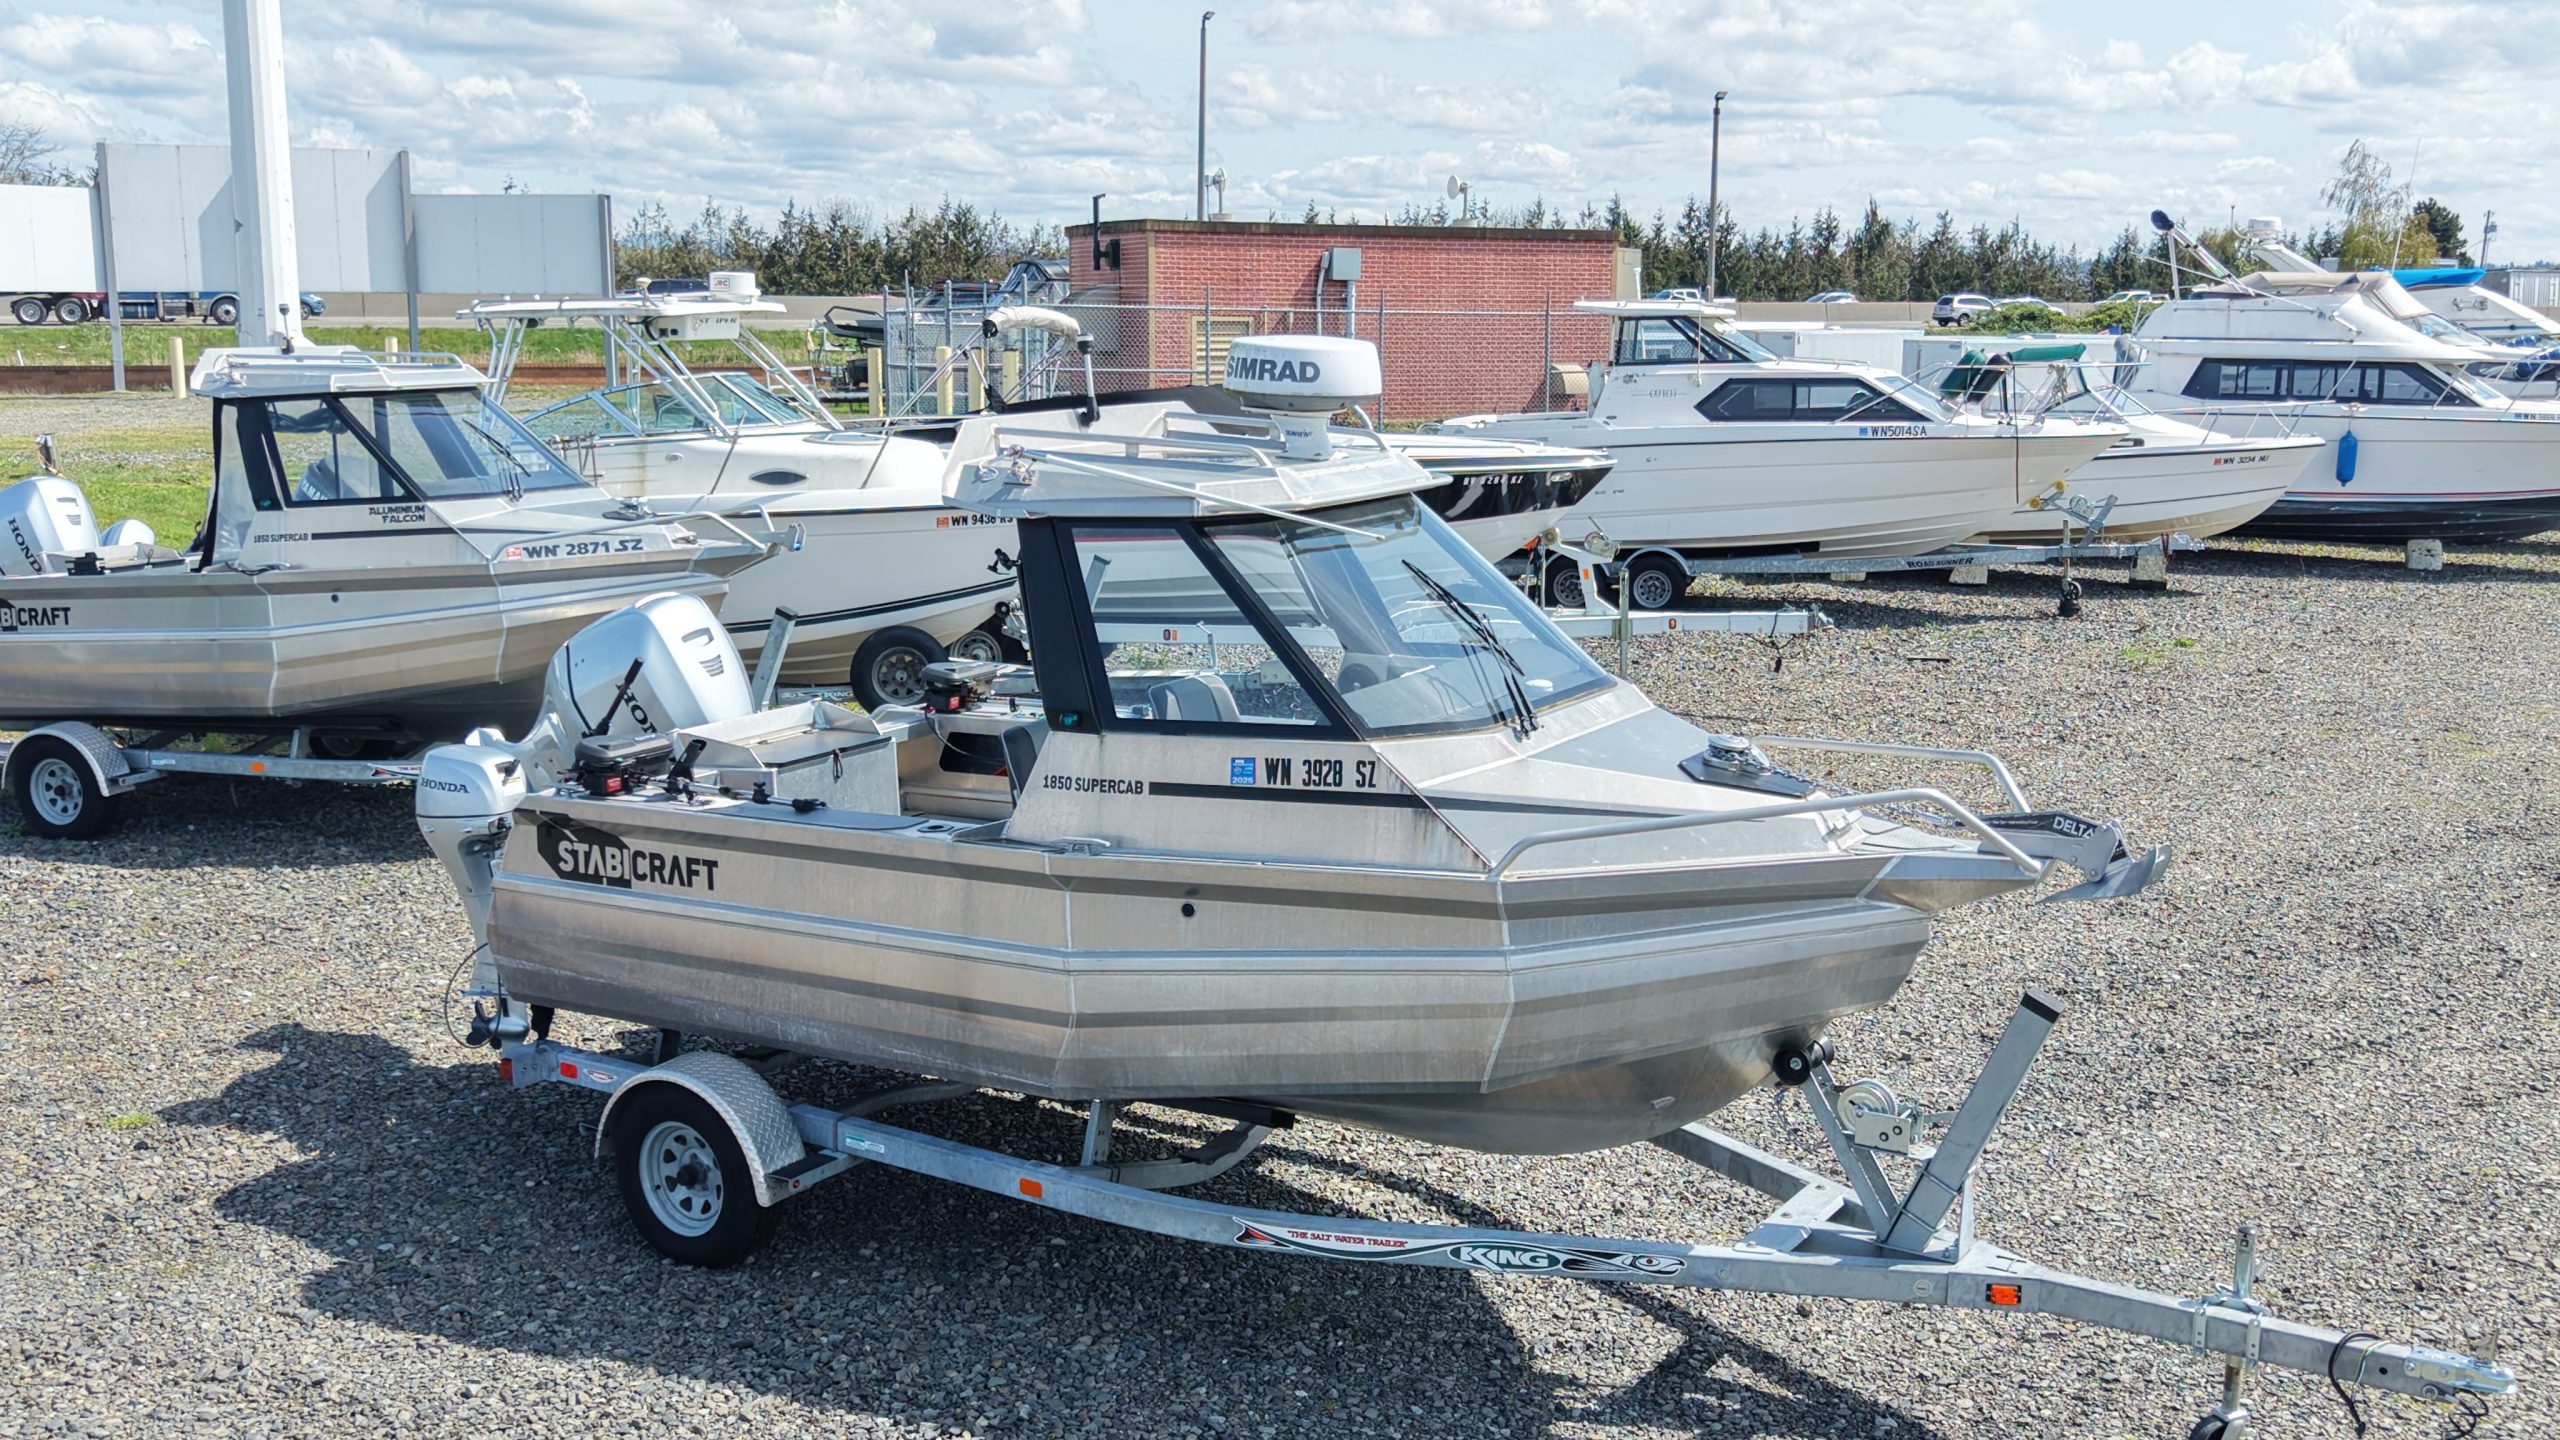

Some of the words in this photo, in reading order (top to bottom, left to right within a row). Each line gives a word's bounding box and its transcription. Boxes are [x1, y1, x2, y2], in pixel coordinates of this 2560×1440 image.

[1226, 355, 1320, 383] SIMRAD
[368, 505, 425, 515] ALUMINIUM
[382, 514, 425, 523] FALCON
[951, 515, 968, 526] WN
[8, 517, 42, 575] HOND
[253, 534, 270, 543] 1850
[271, 533, 308, 543] SUPERCAB
[523, 544, 560, 559] WN
[566, 541, 610, 556] 2871
[614, 538, 643, 552] SZ
[1907, 560, 1934, 568] ROAD
[1936, 557, 1974, 566] RUNNER
[1264, 757, 1292, 787] WN
[1302, 759, 1343, 788] 3928
[1356, 760, 1377, 788] SZ
[421, 778, 470, 794] HONDA
[1043, 774, 1072, 791] 1850
[1075, 776, 1143, 795] SUPERCAB
[2053, 816, 2094, 839] DELTA
[558, 840, 718, 891] STABICRAFT
[1310, 1232, 1332, 1241] SALT
[1334, 1235, 1365, 1245] WATER
[1460, 1247, 1549, 1271] KING
